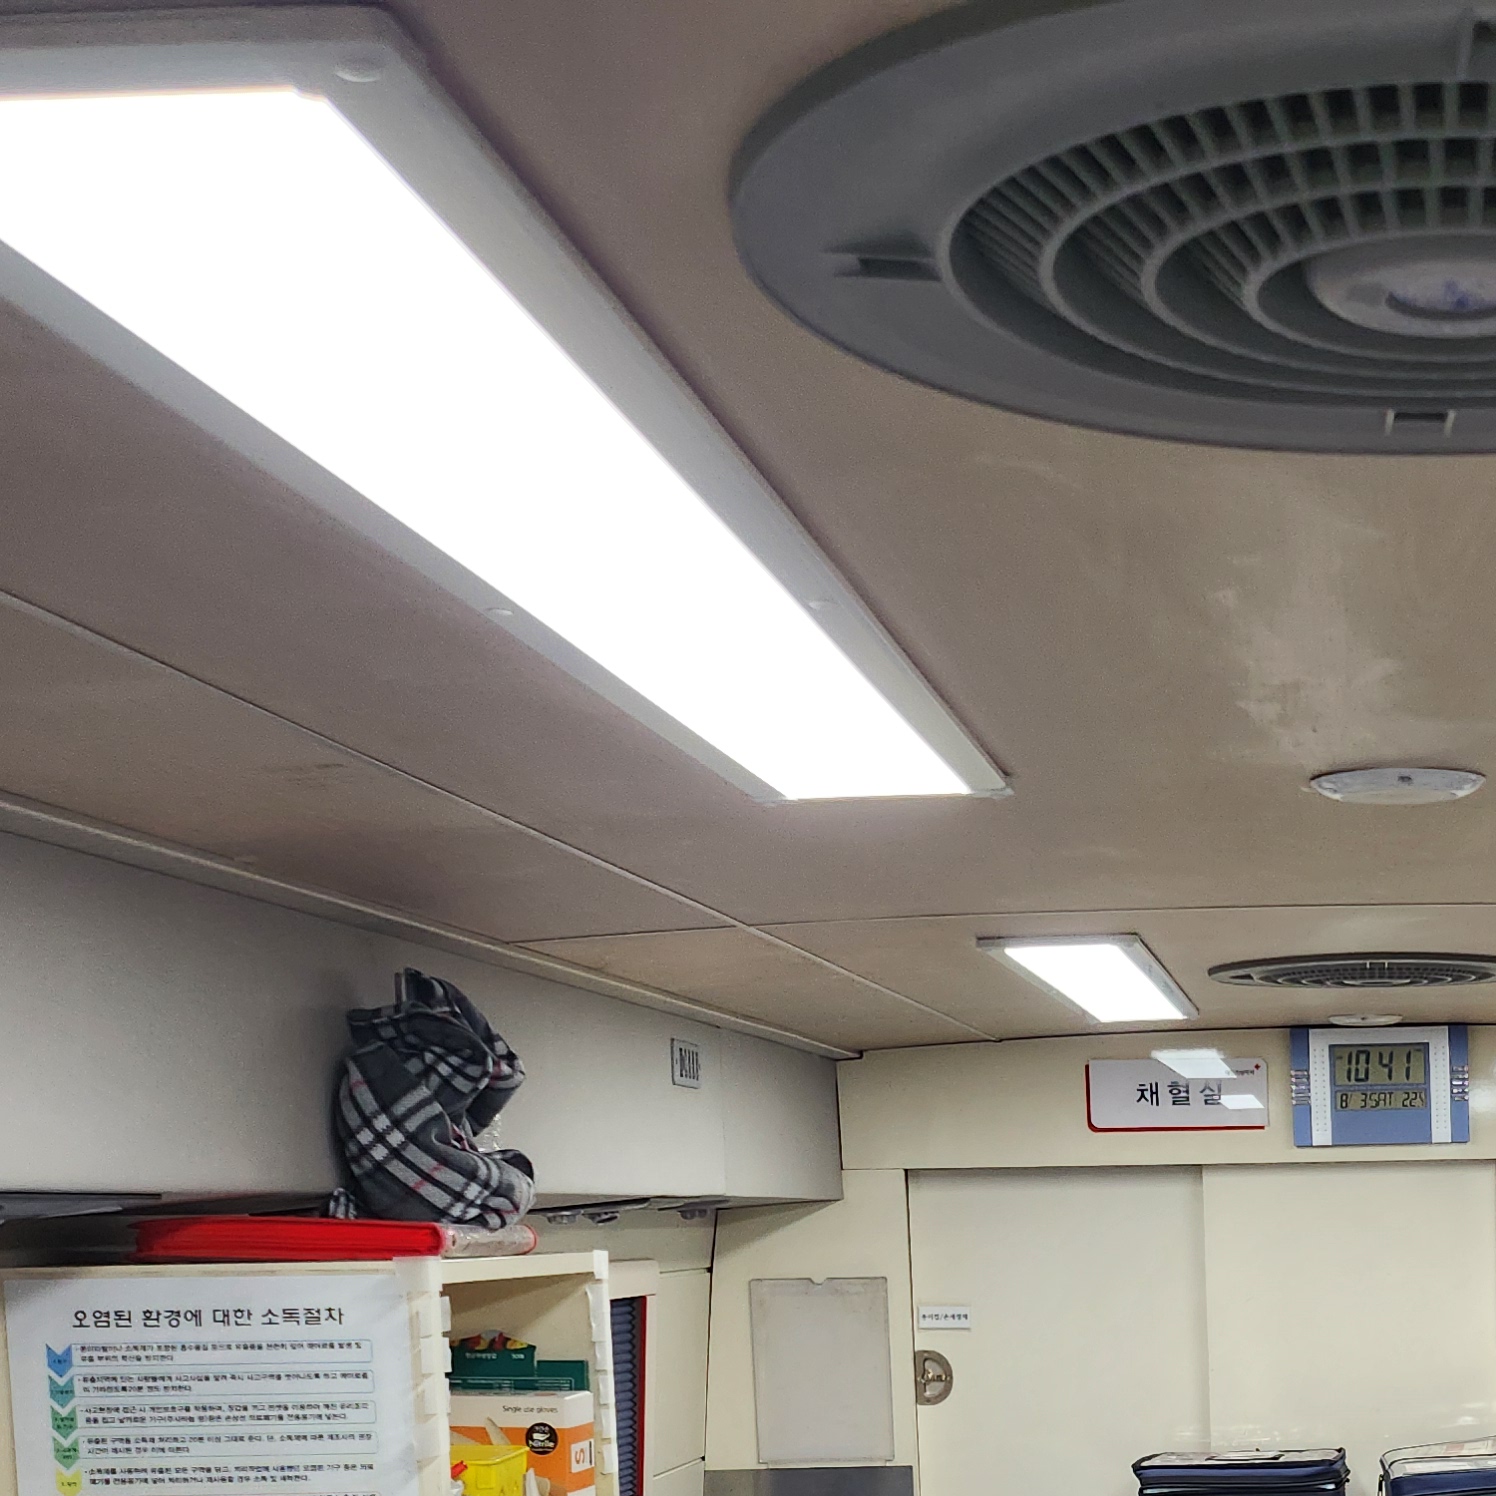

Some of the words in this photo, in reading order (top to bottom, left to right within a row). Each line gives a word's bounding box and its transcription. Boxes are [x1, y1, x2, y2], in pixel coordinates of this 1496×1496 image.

[72, 1309, 133, 1328] 오염된
[141, 1308, 203, 1328] 환경에
[212, 1308, 253, 1327] 대한
[261, 1307, 345, 1327] 소독절차
